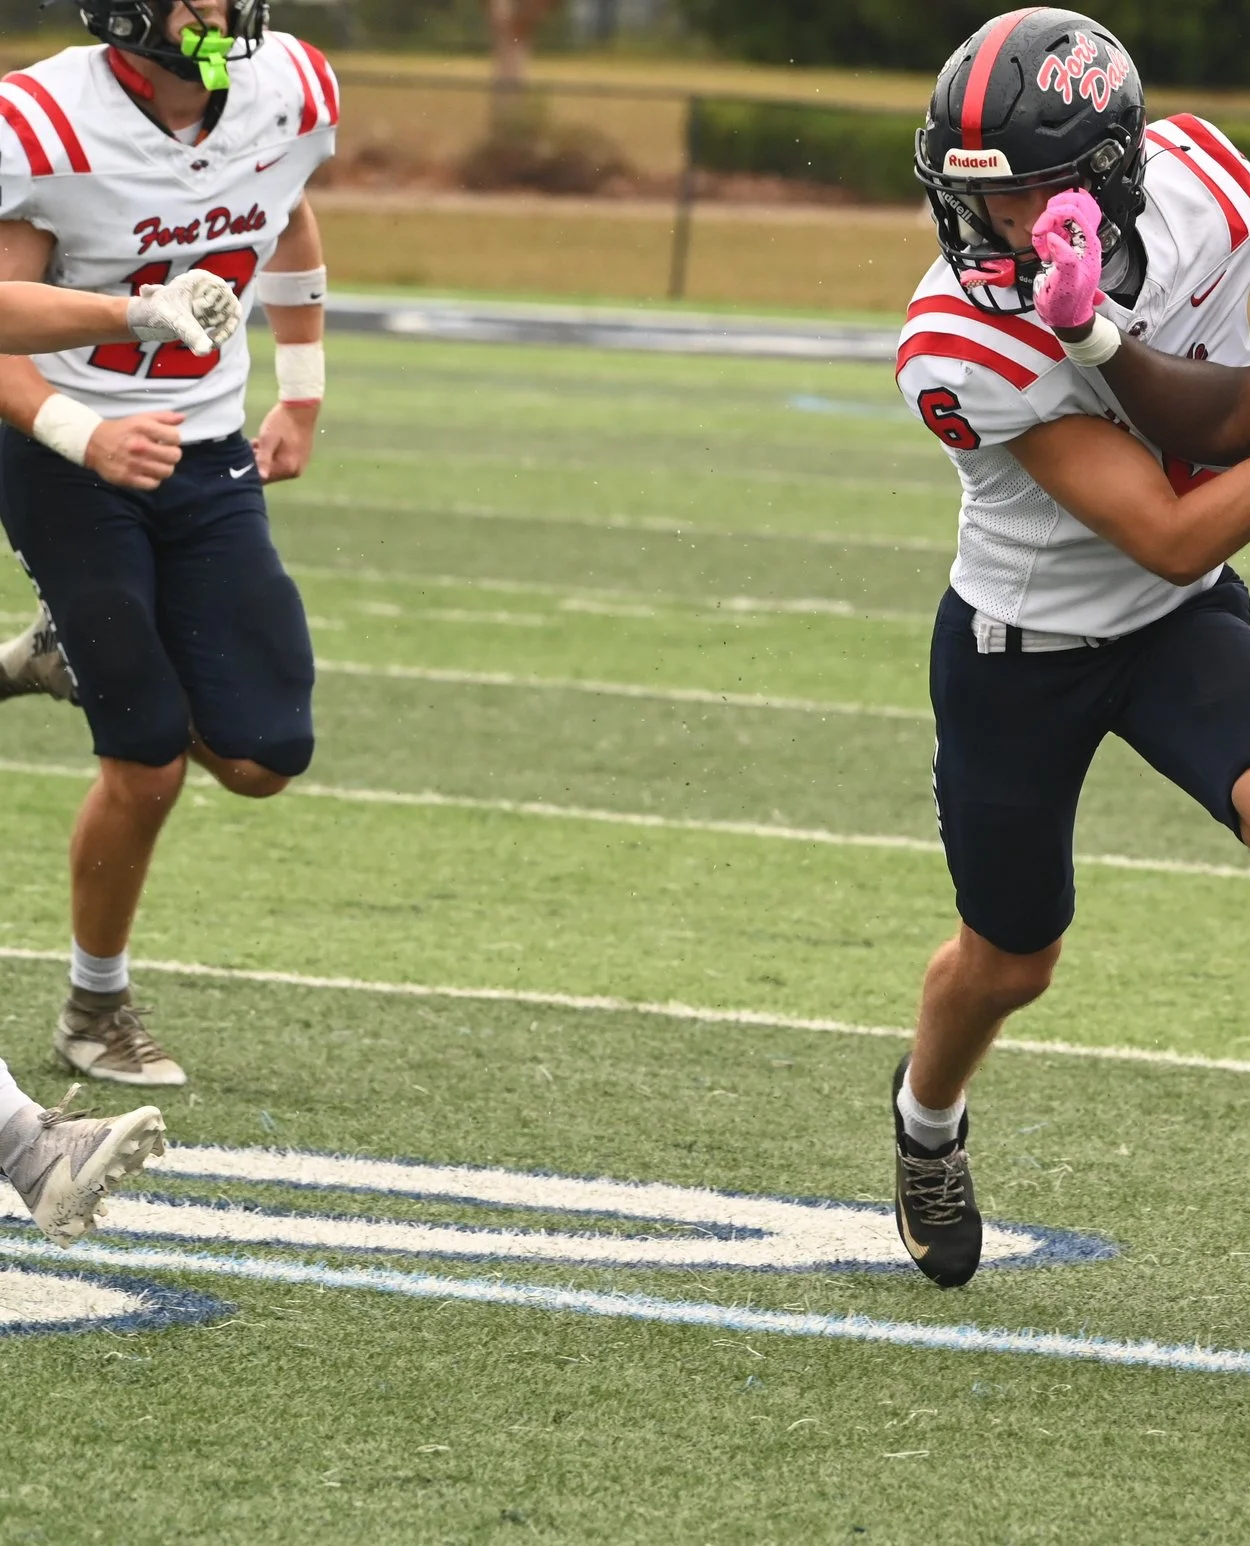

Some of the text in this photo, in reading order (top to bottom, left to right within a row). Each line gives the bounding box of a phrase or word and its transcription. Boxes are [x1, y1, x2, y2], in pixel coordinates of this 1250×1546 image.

[1037, 31, 1098, 105] Fort
[948, 154, 998, 168] Riddell
[133, 202, 266, 255] Fort Dale
[941, 190, 973, 219] iddell
[917, 386, 982, 451] 6
